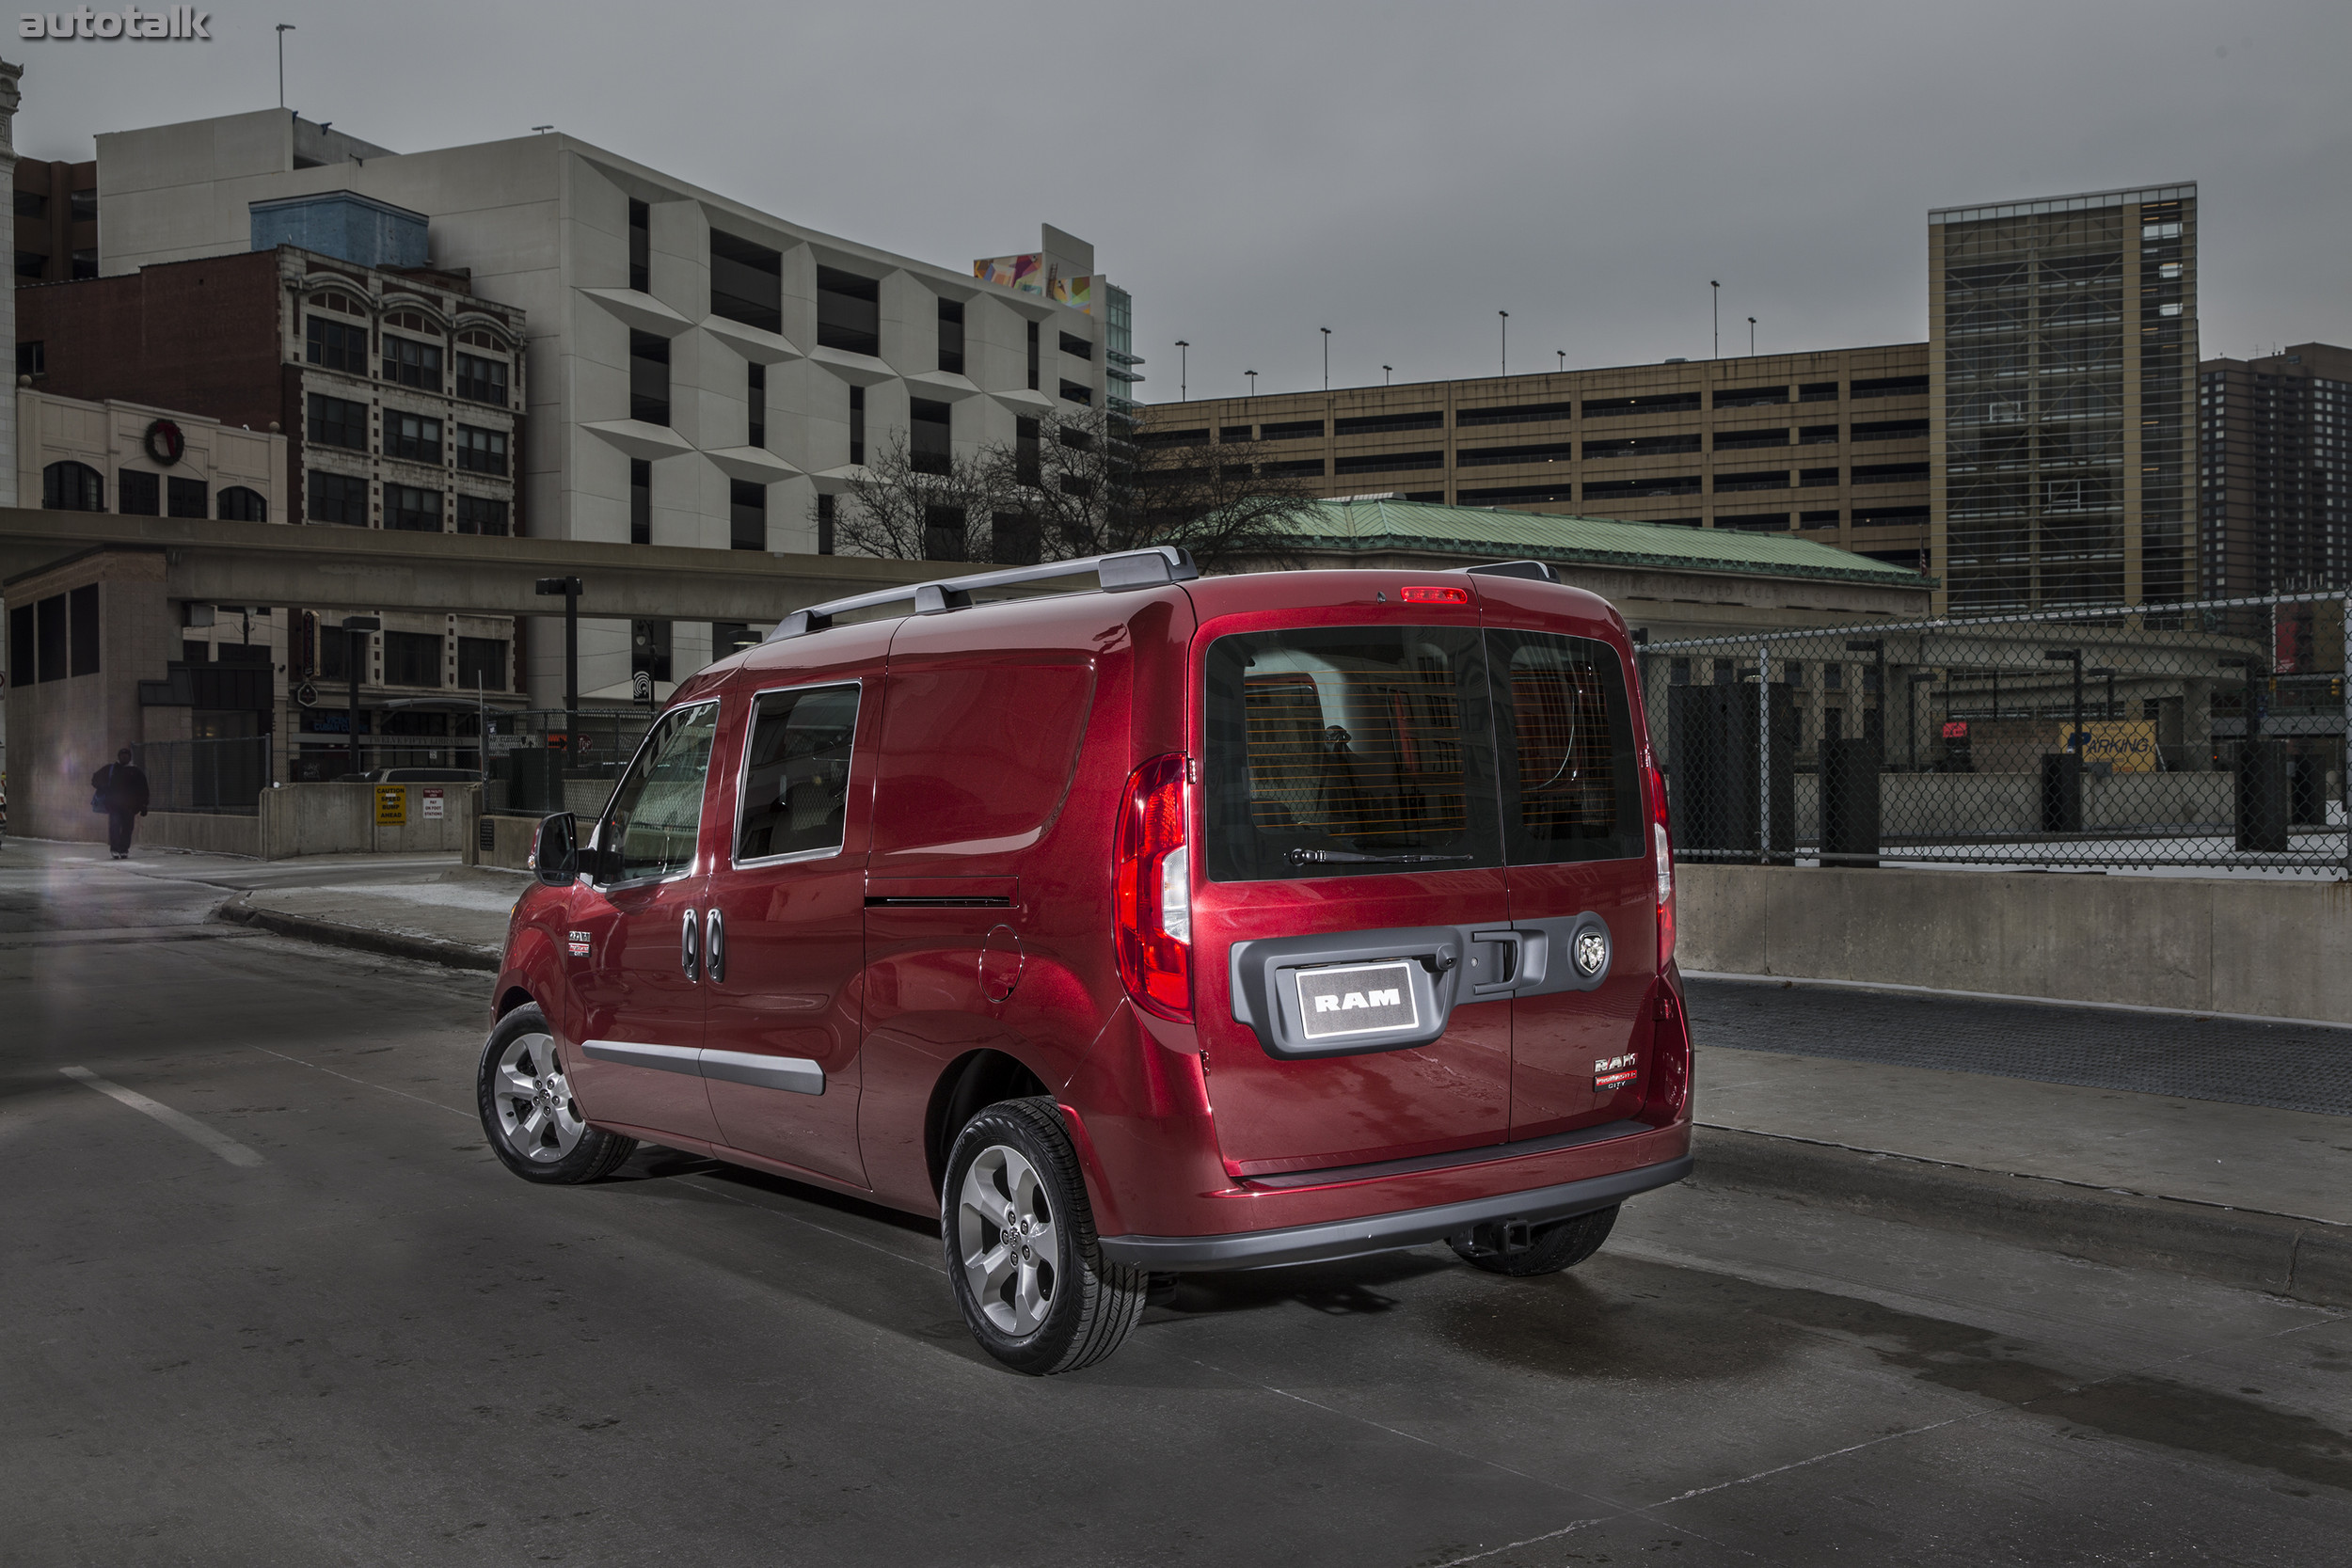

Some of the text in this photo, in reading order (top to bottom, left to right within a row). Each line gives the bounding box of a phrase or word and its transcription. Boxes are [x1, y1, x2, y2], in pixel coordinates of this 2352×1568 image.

[1314, 989, 1401, 1013] RAM
[1595, 1053, 1638, 1072] RAM
[1608, 1081, 1627, 1089] CITY
